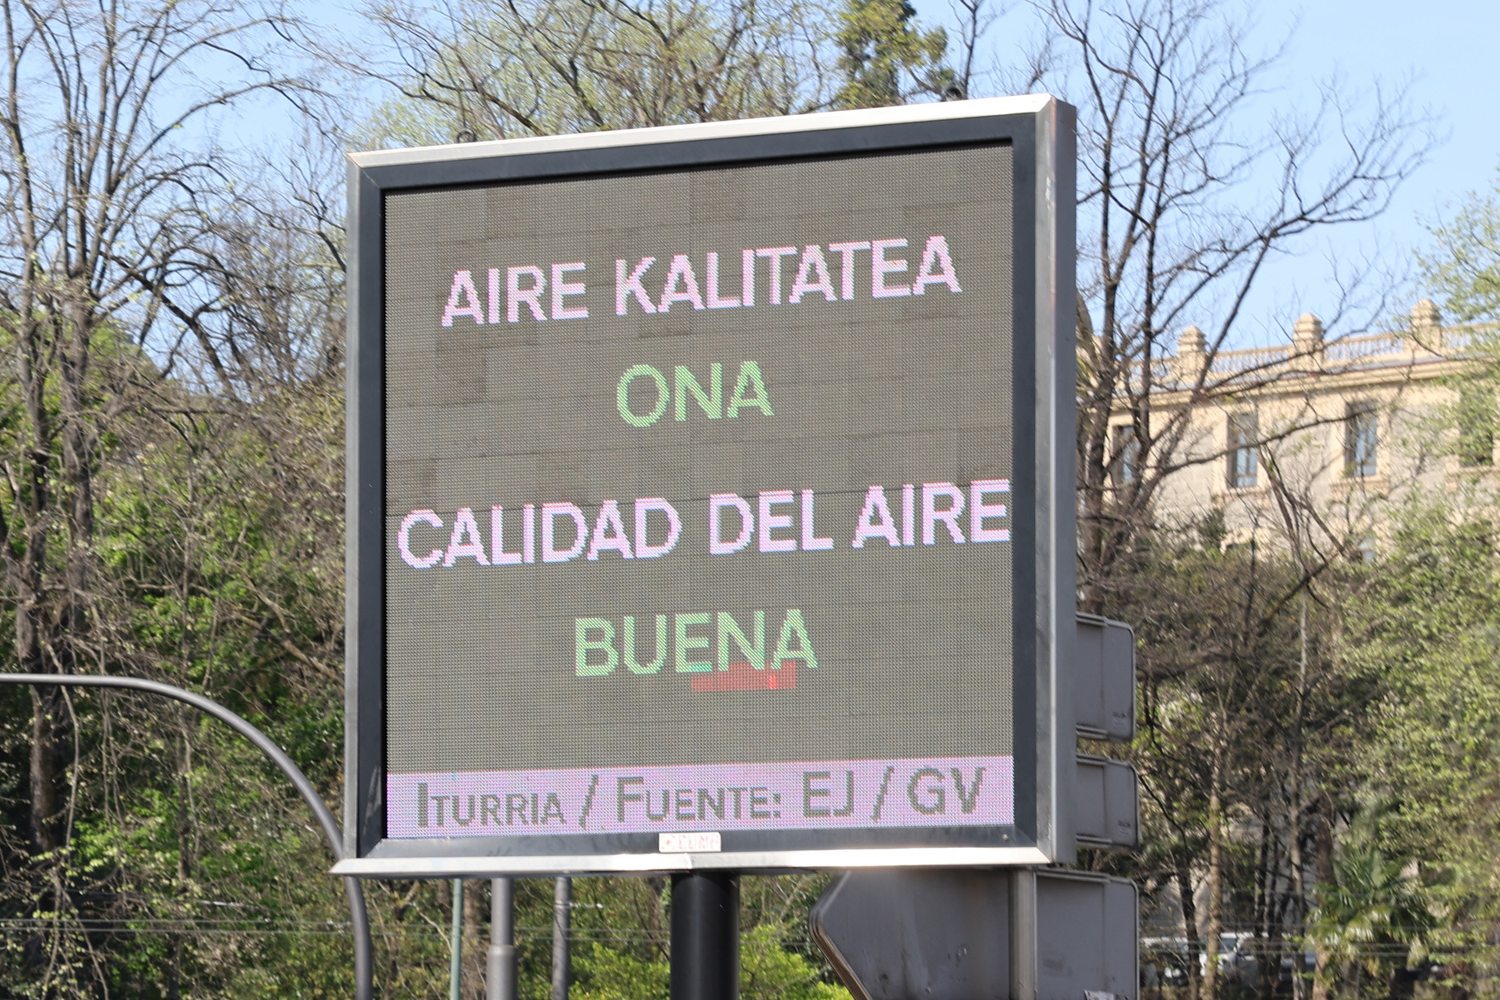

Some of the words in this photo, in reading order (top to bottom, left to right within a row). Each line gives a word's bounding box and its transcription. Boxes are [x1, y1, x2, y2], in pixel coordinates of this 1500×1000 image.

[441, 261, 590, 328] AIRE
[615, 235, 963, 316] KALITATEA
[616, 360, 774, 428] ONA
[398, 497, 682, 569] CALIDAD
[709, 489, 834, 556] DEL
[852, 478, 1011, 549] AIRE
[575, 608, 819, 677] BUENA
[802, 770, 855, 819] EJ
[906, 766, 987, 816] GV
